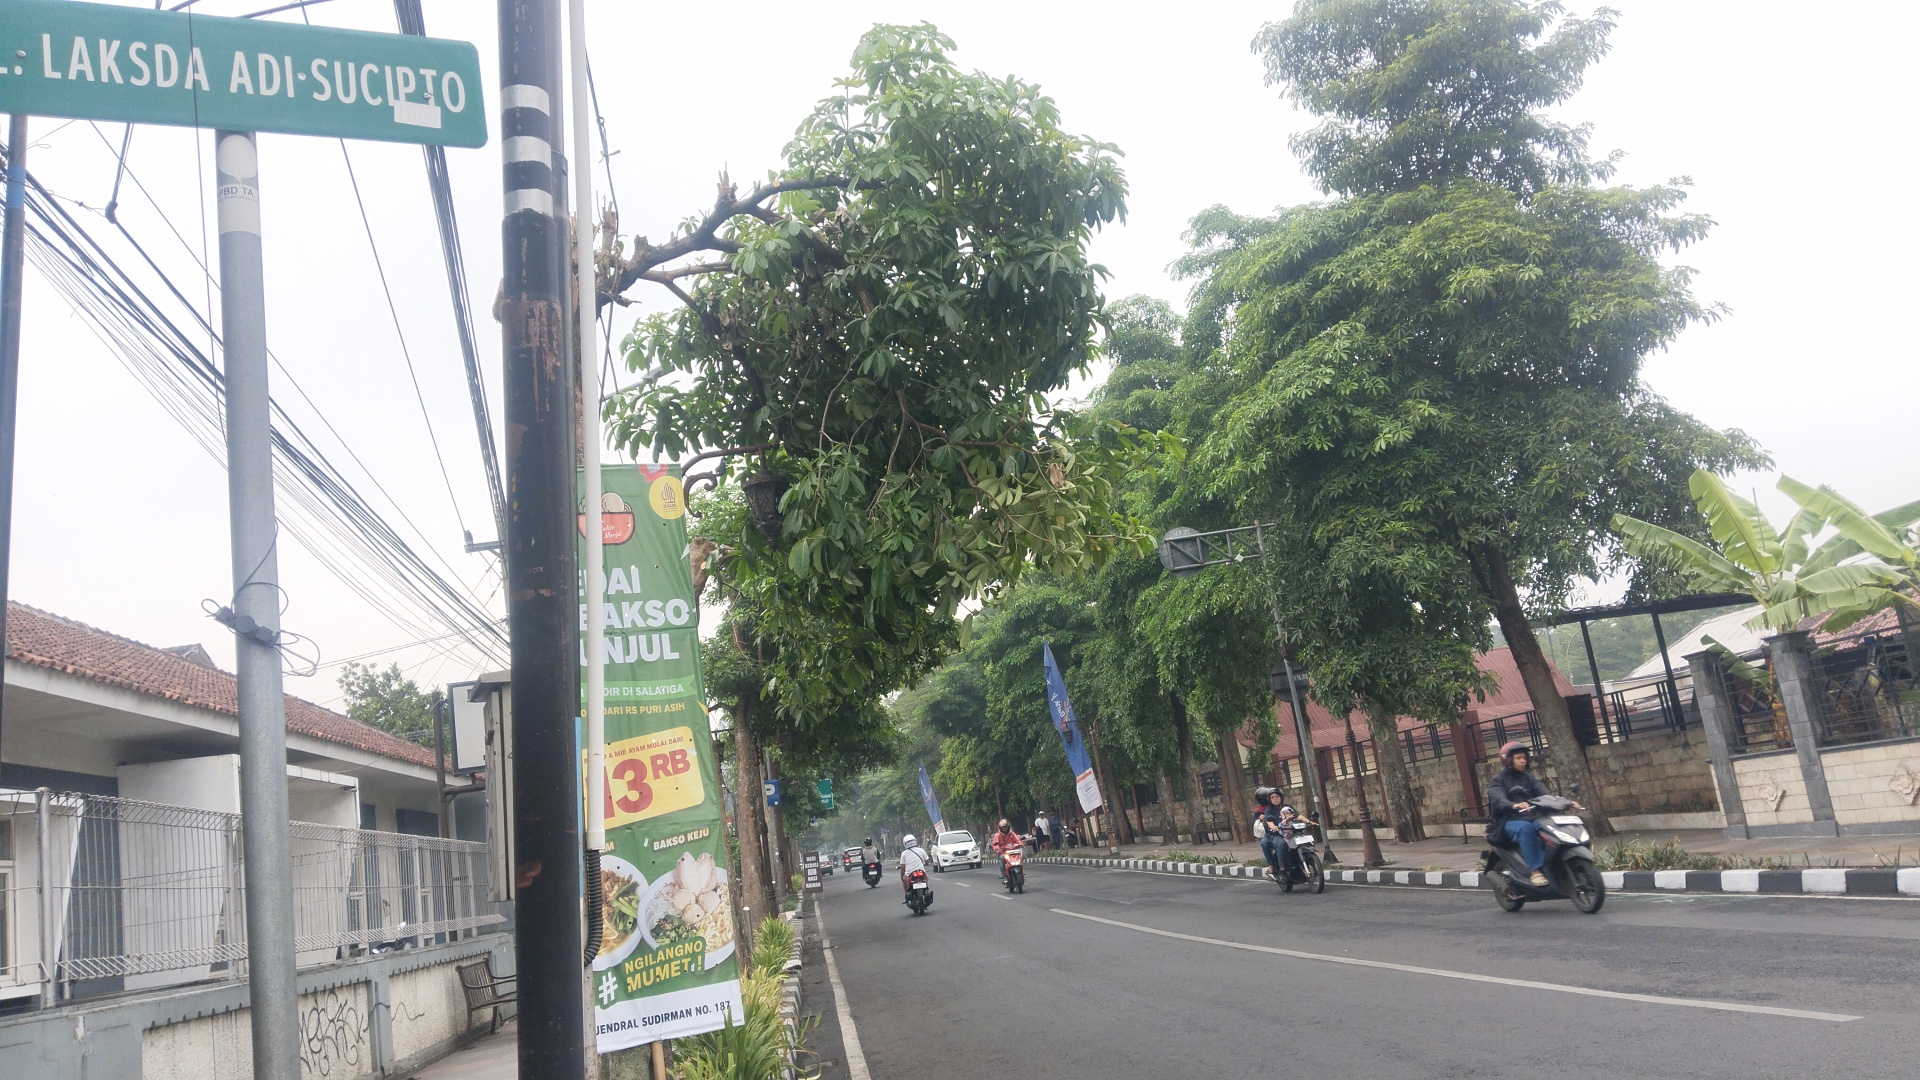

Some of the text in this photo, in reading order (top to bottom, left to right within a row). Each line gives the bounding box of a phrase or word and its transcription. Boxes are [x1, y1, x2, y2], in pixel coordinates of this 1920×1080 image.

[42, 33, 210, 91] LAKSDA
[580, 633, 680, 667] NJUL
[622, 687, 633, 696] DI
[635, 684, 685, 696] SALATIGA
[625, 706, 638, 715] RS
[640, 704, 662, 714] PURI
[664, 702, 685, 713] ASIH
[614, 749, 628, 758] MIE
[628, 744, 646, 754] AYAM
[646, 740, 667, 750] MULAI
[668, 736, 684, 746] DARI
[649, 748, 691, 781] RB
[653, 827, 710, 851] BAKSO KEJU
[624, 940, 703, 974] NGILANGNO
[596, 1000, 730, 1035] JENDRAL SUDIRMAN NO. 187
